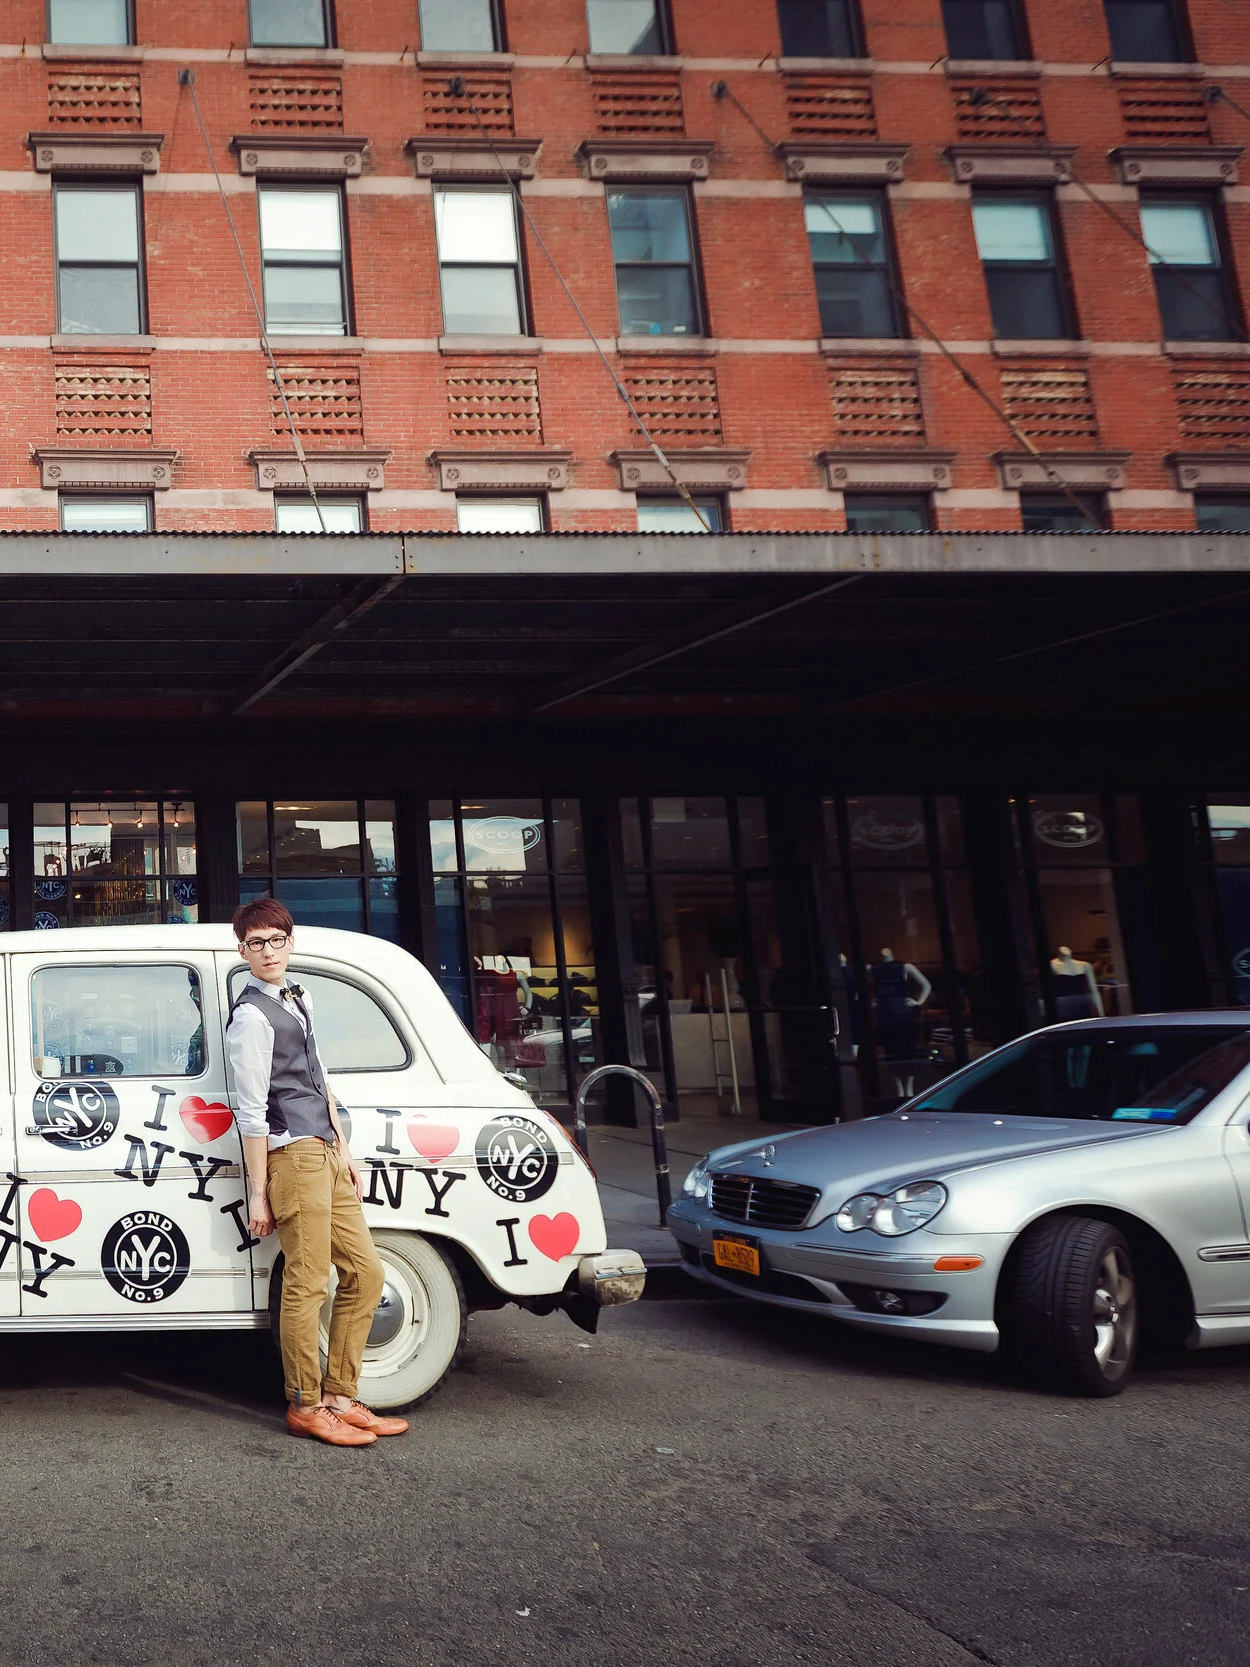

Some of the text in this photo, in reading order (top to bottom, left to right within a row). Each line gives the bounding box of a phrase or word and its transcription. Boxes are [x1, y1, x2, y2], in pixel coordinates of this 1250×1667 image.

[474, 830, 533, 839] SCOOP
[42, 881, 60, 891] NYC
[181, 883, 197, 899] NYC
[54, 1086, 101, 1129] NYC
[143, 1085, 177, 1132] I
[499, 1116, 549, 1145] BOND
[375, 1108, 402, 1156] I
[114, 1133, 234, 1203] NY
[491, 1134, 543, 1181] NYC
[363, 1156, 467, 1218] NY
[121, 1212, 174, 1232] BOND
[219, 1199, 262, 1252] I
[496, 1217, 528, 1267] I
[120, 1234, 172, 1281] NYC
